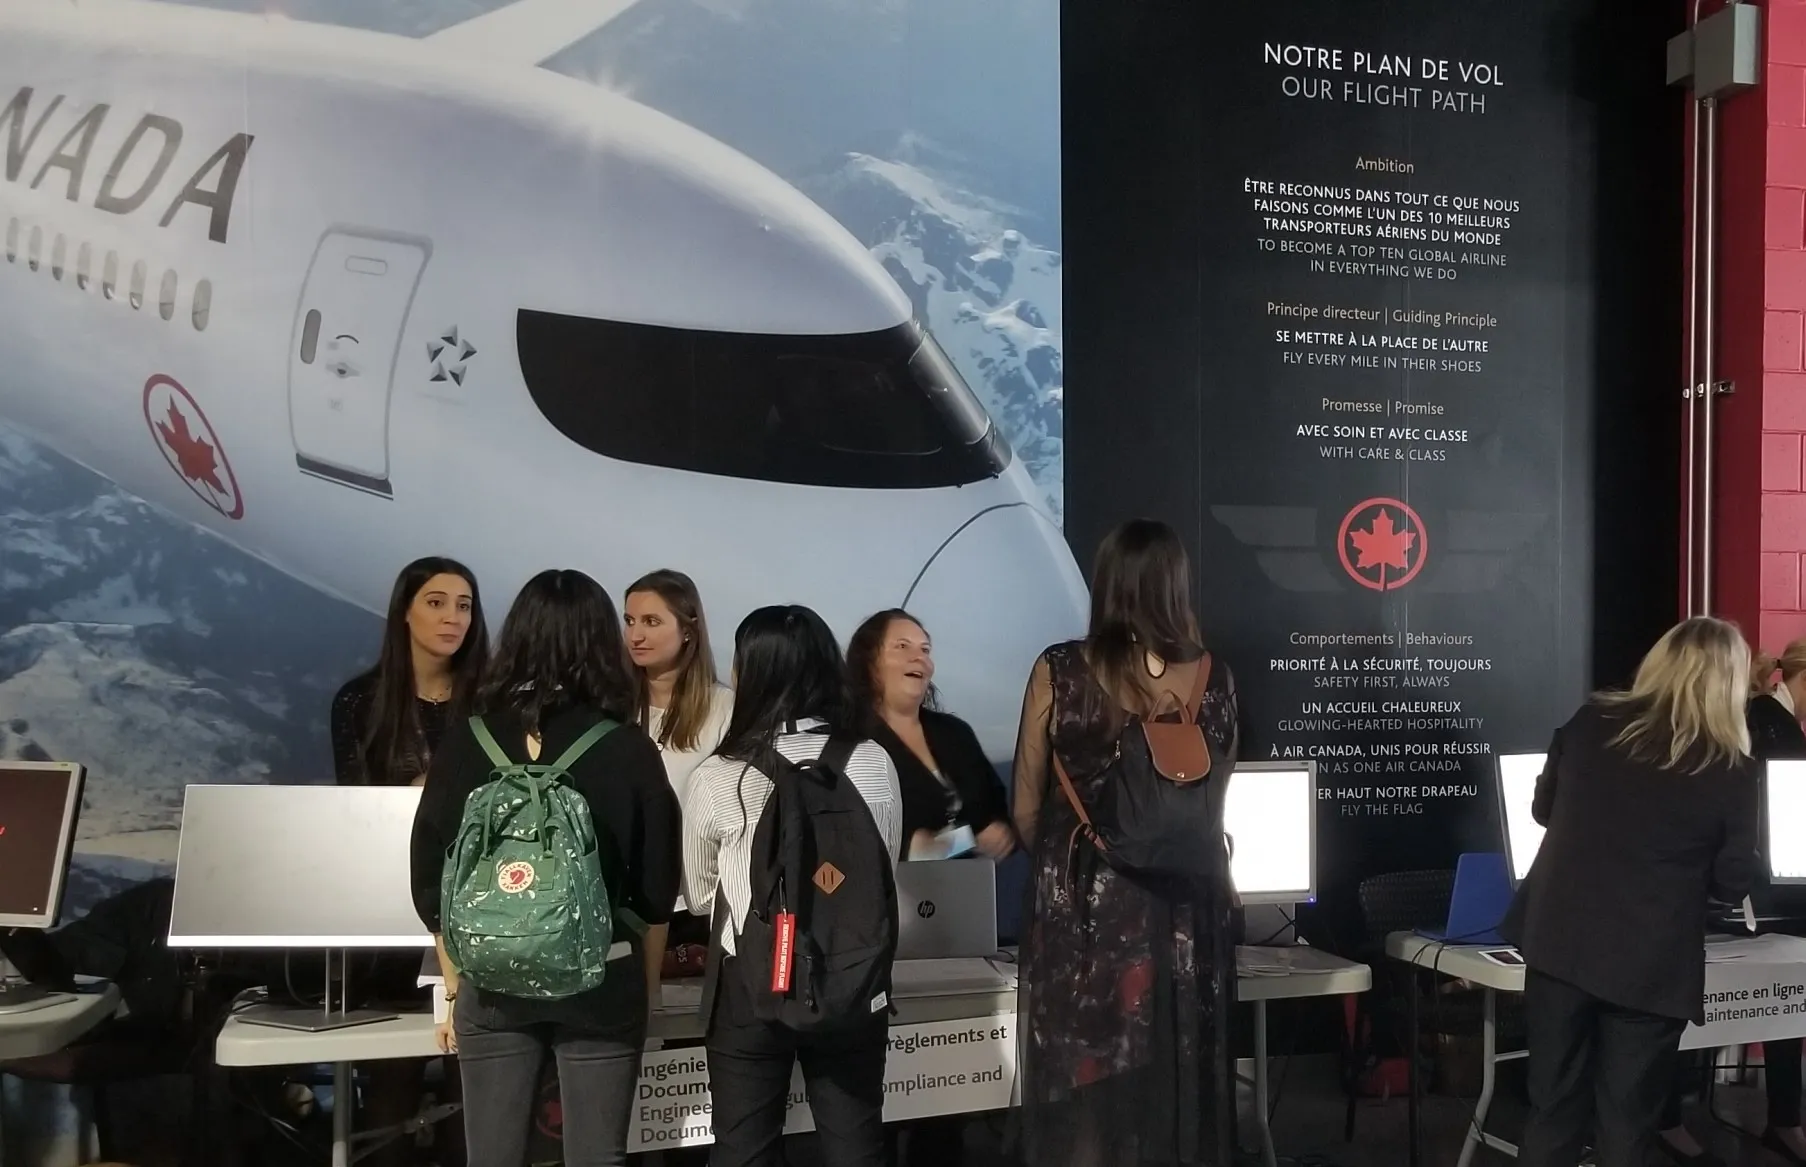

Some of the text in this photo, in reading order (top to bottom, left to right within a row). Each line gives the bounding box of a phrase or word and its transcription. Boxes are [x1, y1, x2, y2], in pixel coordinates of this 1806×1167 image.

[1264, 42, 1504, 86] NOTRE PLAN DE VOL
[1281, 76, 1485, 114] OUR FLIGHT PATH
[1355, 156, 1414, 174] Ambition
[1244, 177, 1520, 213] ÊTRE RECONNUS DANS TOUT CE QUE NOUS
[1254, 198, 1511, 229] FAISONS COMME L'UN DES 10 MEILLEURS
[1263, 217, 1501, 246] TRANSPORTEURS AÉRIENS DU MONDE
[1257, 238, 1507, 267] TO BECOME A TOP TEN GLOBAL AIRLINE
[1310, 259, 1457, 280] IN EVERYTHING WE DO
[1267, 301, 1319, 321] Principe
[1322, 304, 1381, 321] directeur
[1392, 309, 1442, 328] Guiding
[1445, 311, 1497, 331] Principle
[1275, 330, 1489, 353] SE METTRE À LA PLACE DE L'AUTRE
[1283, 351, 1482, 373] FLY EVERY MILE IN THEIR SHOES
[1322, 397, 1383, 413] Promesse
[1395, 400, 1444, 415] Promise
[1296, 424, 1468, 442] AVEC SOIN ET AVEC CLASSE
[1319, 445, 1446, 461] WITH CARE & CLASS
[1289, 631, 1394, 649] Comportements
[1405, 632, 1473, 645] Behaviours
[1270, 656, 1492, 673] PRIORITÉ À LA SÉCURITÉ, TOUJOURS
[1314, 675, 1450, 689] SAFETY FIRST, ALWAYS
[1302, 701, 1461, 714] UN ACCUEIL CHALEUREUX
[1278, 717, 1484, 732] GLOWING-HEARTED HOSPITALITY
[1270, 740, 1491, 758] À AIR CANADA, UNIS POUR RÉUSSIR
[1319, 759, 1462, 774] N AS ONE AIR CANADA
[1318, 785, 1478, 800] ER HAUT NOTRE DRAPEAU
[1341, 802, 1423, 816] FLY THE FLAG
[918, 900, 935, 919] hp
[1702, 982, 1804, 1004] enance en ligne
[1706, 998, 1806, 1022] aintenance and
[638, 1025, 1008, 1081] Ingénie règlements et
[640, 1102, 712, 1124] Enginee
[881, 1072, 966, 1096] ompliance
[971, 1065, 1003, 1083] and
